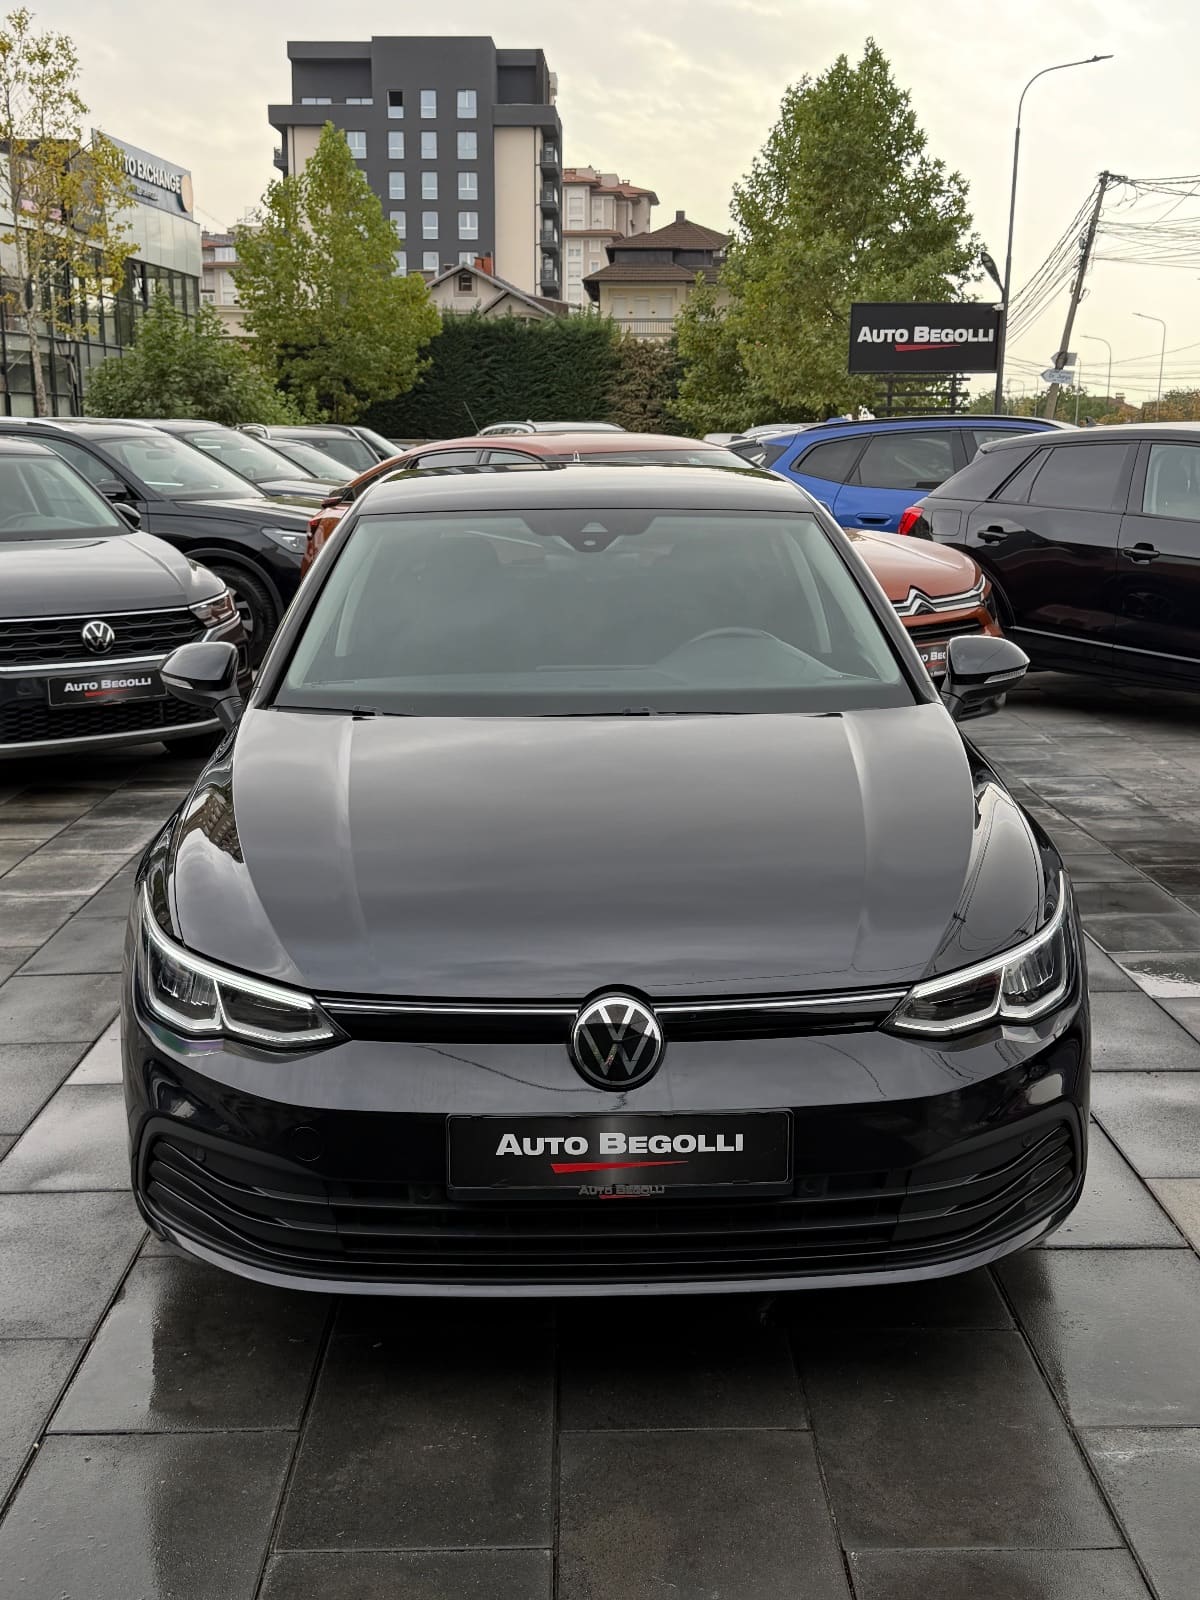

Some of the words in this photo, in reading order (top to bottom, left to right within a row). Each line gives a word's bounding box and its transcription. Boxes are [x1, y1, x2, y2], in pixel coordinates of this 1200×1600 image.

[137, 159, 181, 194] EXCHANGE
[857, 326, 909, 343] AUTO
[913, 326, 994, 343] BEGOLLI
[64, 682, 98, 692] AUTO
[101, 678, 152, 689] BEGOLLI
[495, 1133, 589, 1156] AUTO
[599, 1132, 744, 1155] BEGOLLI
[579, 1184, 613, 1195] AUTO
